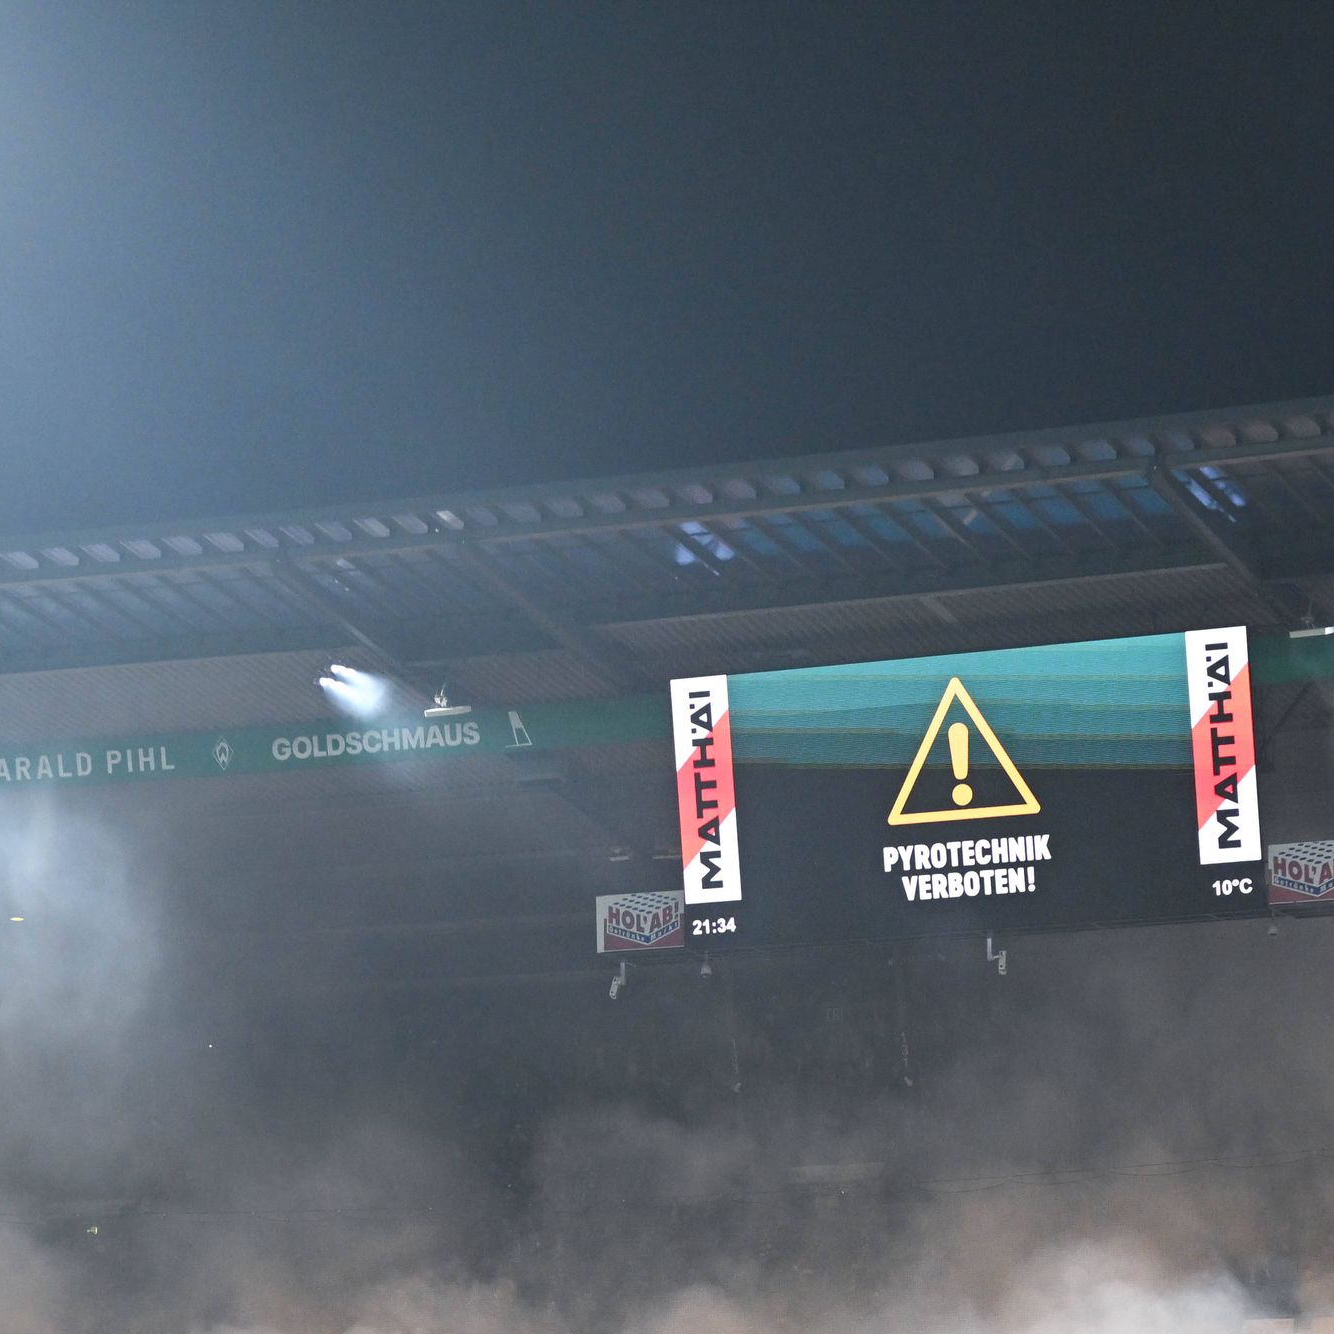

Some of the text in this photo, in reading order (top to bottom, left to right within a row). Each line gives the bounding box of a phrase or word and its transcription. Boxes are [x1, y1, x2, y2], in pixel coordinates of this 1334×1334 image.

[106, 746, 176, 774] PIHL
[271, 722, 481, 761] GOLDSCHMAUS
[1204, 641, 1244, 850] MATTHÄI
[688, 690, 723, 889] MATTHÄI
[882, 834, 1053, 875] PYROTECHNIK
[901, 863, 1037, 902] VERBOTEN!
[692, 916, 737, 936] 21:34
